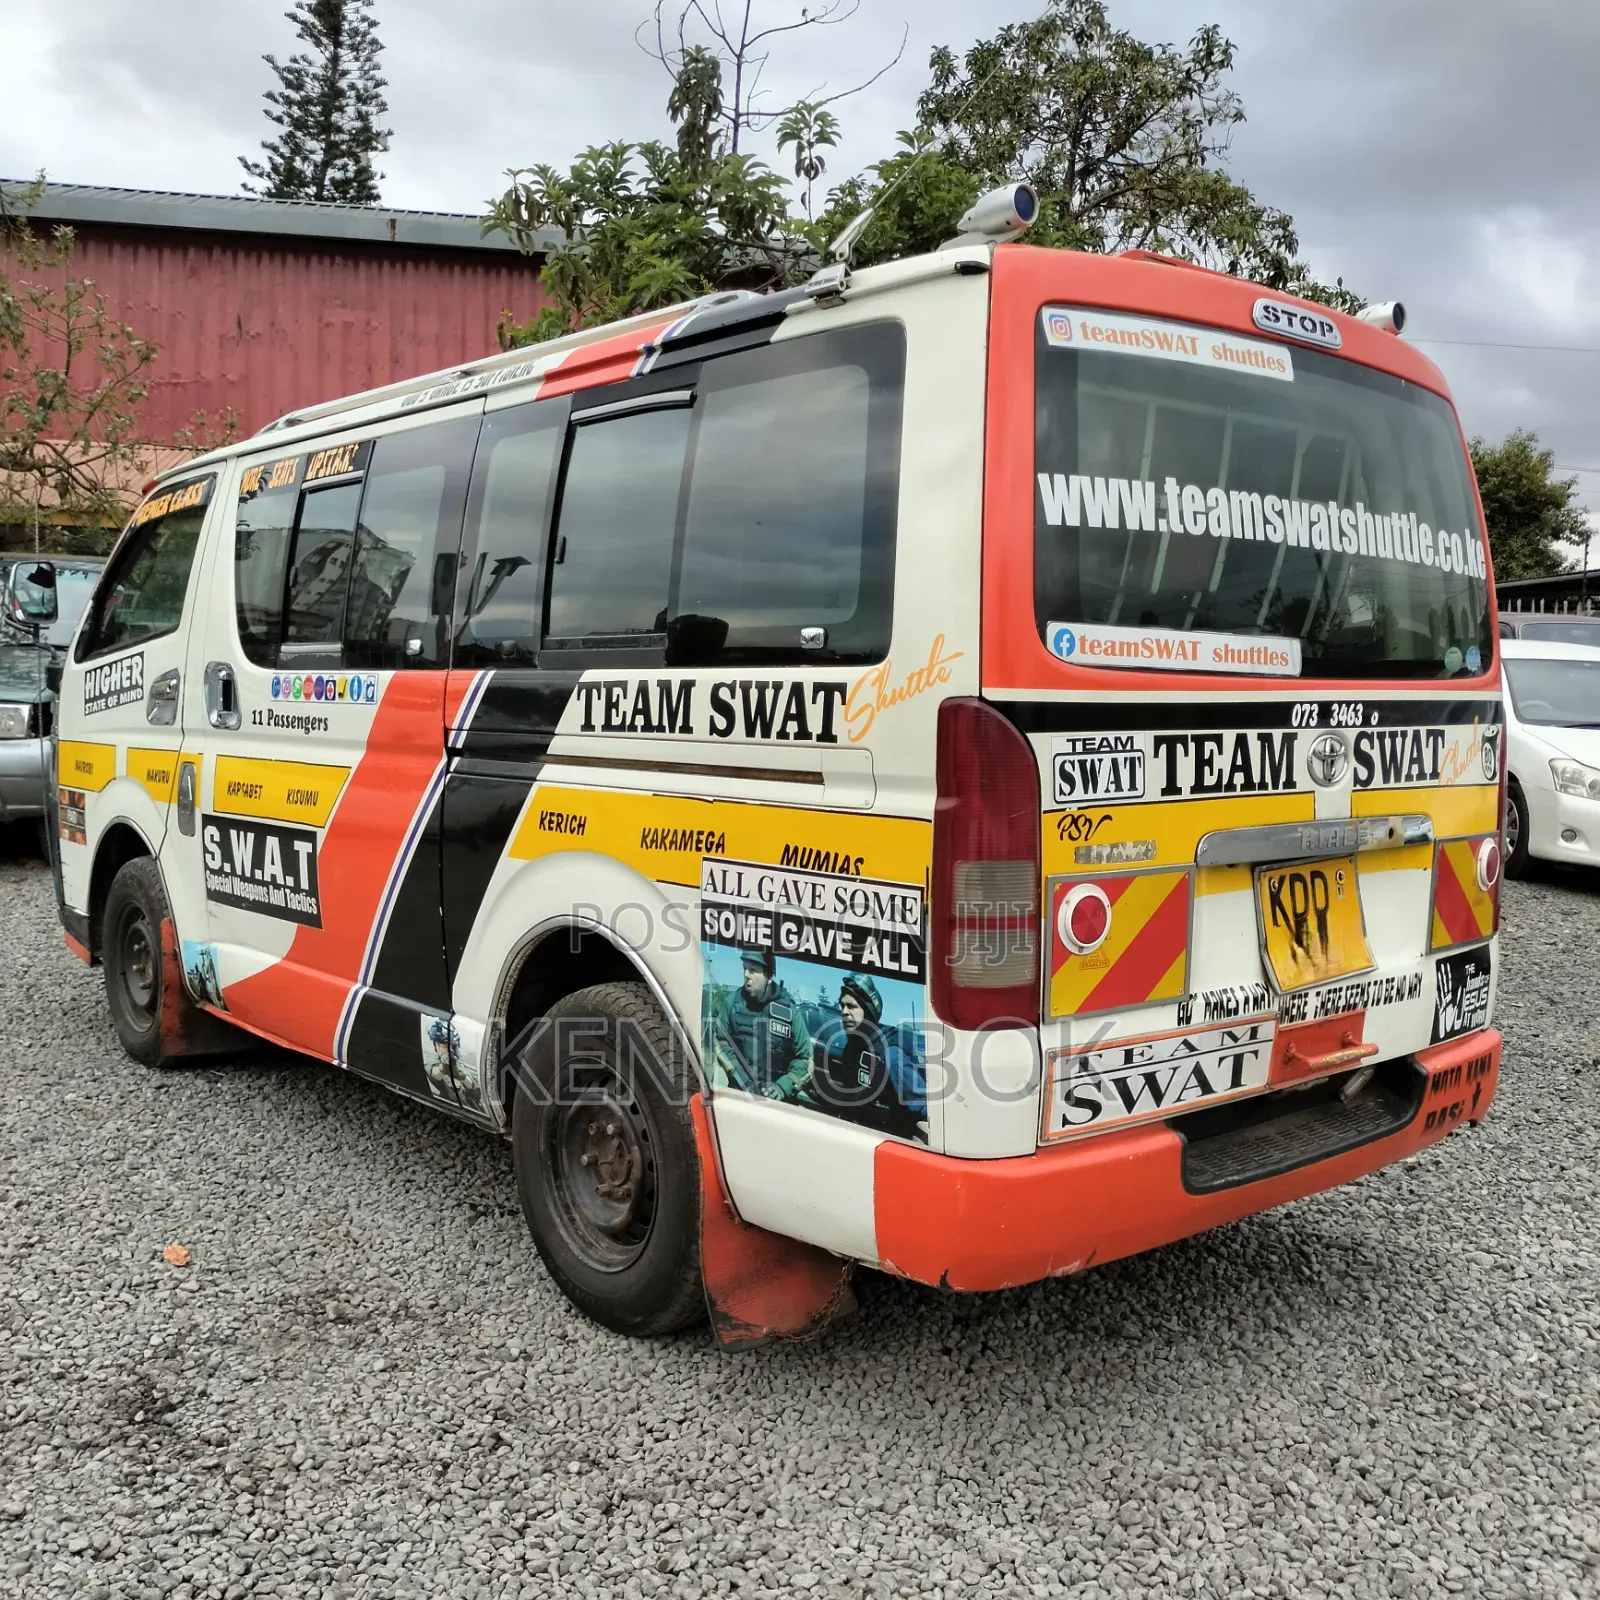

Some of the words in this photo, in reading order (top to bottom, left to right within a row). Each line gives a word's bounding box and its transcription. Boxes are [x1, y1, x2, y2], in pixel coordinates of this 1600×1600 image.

[1262, 304, 1334, 338] STOP
[1080, 321, 1199, 356] teamSWAT
[1212, 342, 1286, 373] shuttles
[1037, 473, 1487, 580] www.teamswatshuttle.co.ke
[1079, 633, 1201, 661] teamSWAT
[1212, 644, 1289, 667] shuttles
[85, 655, 143, 700] HIGHER
[577, 679, 696, 734] TEAM
[708, 680, 848, 744] SWAT
[843, 633, 964, 743] Shuttle
[85, 700, 106, 715] STATE
[108, 695, 118, 707] OF
[120, 688, 143, 705] MIND
[252, 710, 264, 726] 11
[267, 708, 329, 735] Passengers
[1066, 735, 1135, 753] TEAM
[147, 768, 171, 784] NAKURU
[1058, 756, 1142, 797] SWAT
[1153, 732, 1298, 797] TEAM
[1353, 729, 1446, 788] SWAT
[286, 788, 319, 807] KISUMU
[538, 810, 587, 836] KERICH
[640, 827, 726, 854] KAKAMEGA
[1057, 813, 1113, 842] PSV
[204, 825, 313, 890] S.W.A.T
[780, 844, 864, 877] MUMIAS
[205, 870, 232, 895] Special
[232, 876, 269, 903] Weapons
[269, 885, 286, 907] And
[285, 888, 318, 915] Tactics
[703, 867, 751, 899] ALL
[757, 875, 826, 912] GAVE
[833, 886, 919, 926] SOME
[704, 907, 773, 947] SOME
[780, 921, 853, 962] GAVE
[861, 938, 919, 974] ALL
[1465, 963, 1475, 975] THE
[1201, 987, 1239, 1022] MAKES
[1341, 981, 1372, 1012] SEEMS
[1371, 979, 1383, 1008] TO
[1383, 977, 1395, 1005] BE
[1395, 975, 1407, 1003] NO
[771, 1022, 789, 1036] SWAT
[1064, 1024, 1263, 1074] TEAM
[1062, 1049, 1260, 1128] SWAT
